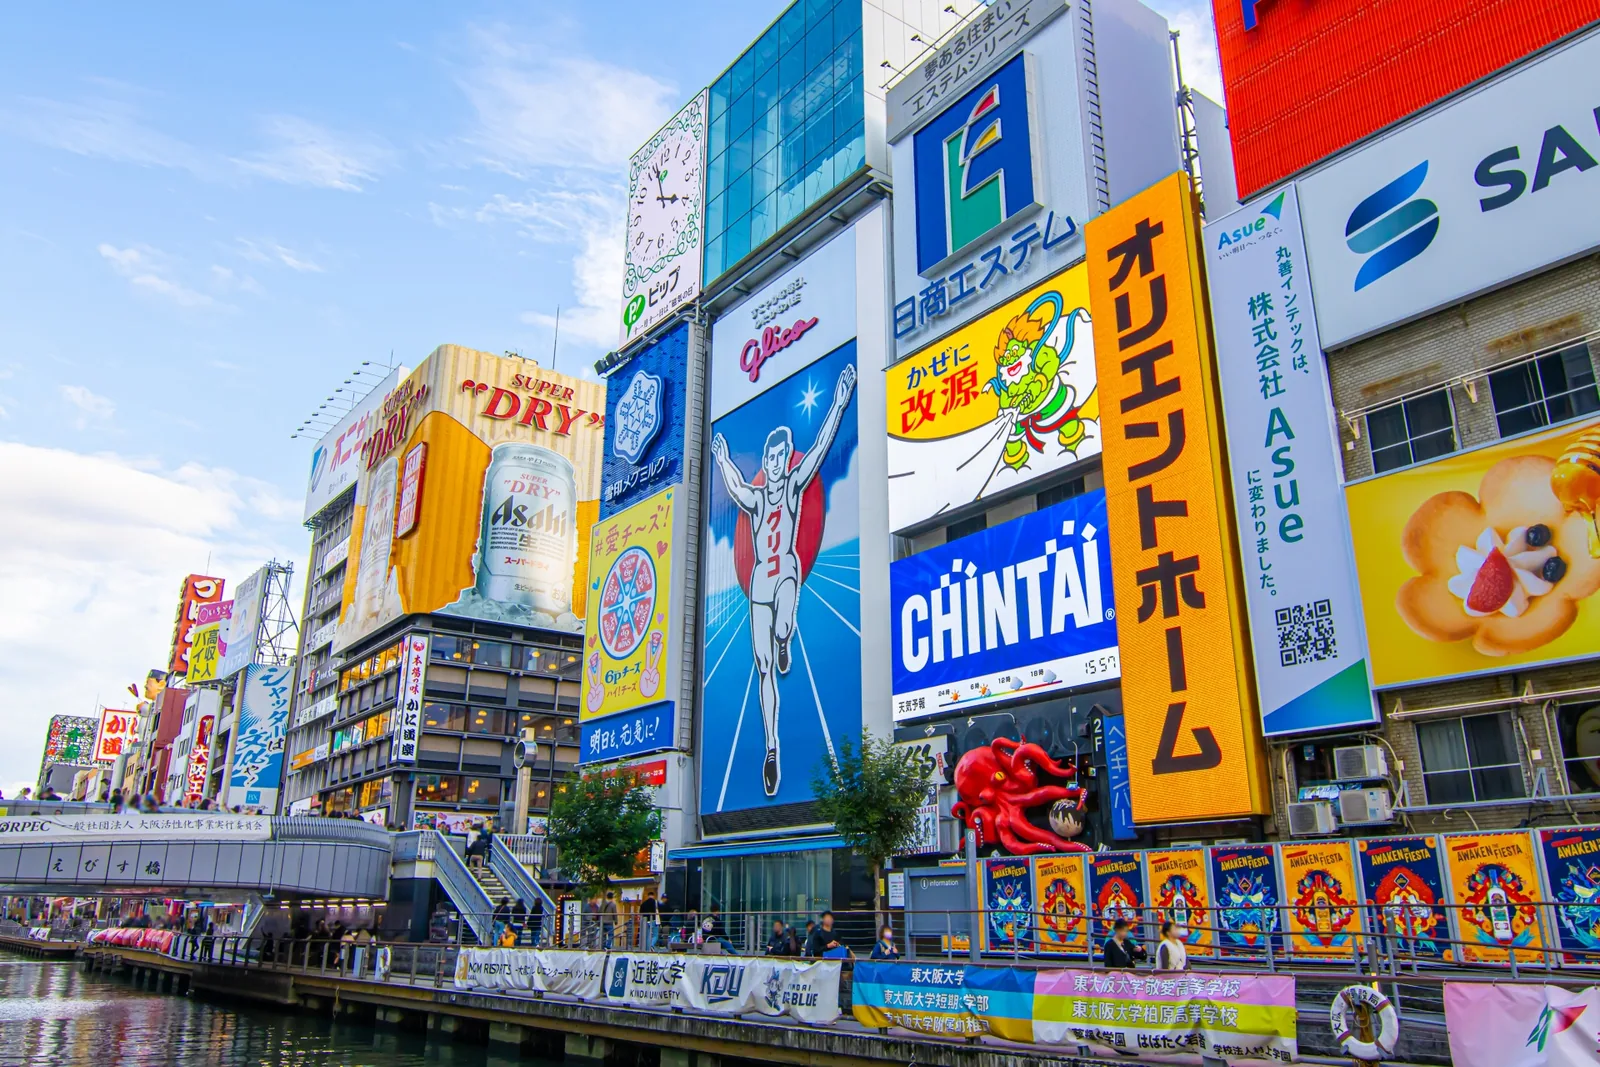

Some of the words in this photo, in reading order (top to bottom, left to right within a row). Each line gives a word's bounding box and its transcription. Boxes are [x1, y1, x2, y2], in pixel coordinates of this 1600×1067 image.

[924, 1, 1012, 82] 夢ある住まい
[912, 8, 1030, 116] エステムシリーズ
[660, 147, 671, 166] 12
[674, 143, 682, 159] 1
[681, 149, 692, 166] 2
[1474, 105, 1600, 213] SA
[685, 168, 695, 183] 3
[637, 187, 648, 205] 10
[681, 195, 690, 207] 4
[635, 231, 645, 247] 8
[645, 239, 654, 255] 7
[657, 232, 665, 249] 6
[1218, 216, 1266, 251] Asue
[1218, 227, 1284, 260] いい明日へ、つなぐ。
[649, 265, 681, 307] ピップ
[894, 210, 1078, 340] 日商エステム
[1275, 245, 1310, 375] 丸善インテックは、
[740, 317, 819, 383] Glico
[1248, 291, 1286, 400] 株式会社
[906, 343, 971, 391] かぜに
[511, 373, 575, 403] SUPER
[900, 361, 980, 435] 改源
[520, 473, 548, 485] SUPER
[604, 455, 667, 502] 雪印メグミルク
[1265, 407, 1304, 543] Asue
[1107, 217, 1223, 775] オリエントホーム
[491, 494, 567, 538] Asahi
[766, 505, 784, 578] グリコ
[1247, 469, 1277, 597] に変わりました。
[901, 520, 1104, 673] CHINTAI
[191, 632, 207, 680] バイト
[409, 655, 423, 696] 本場の味
[607, 681, 638, 698] ハイ!チーズ
[259, 667, 291, 752] シャッターは
[898, 696, 926, 714] 天気予報
[401, 698, 420, 757] かに道楽
[590, 716, 660, 756] 明日も、元気に!
[1093, 718, 1103, 752] 2F
[61, 819, 134, 832] 一般社団法人
[138, 818, 263, 832] 大阪活性化事業実行委員会
[1290, 854, 1320, 868] AWAKEN
[1320, 853, 1343, 866] FIESTA
[1371, 850, 1404, 866] AWAKEN
[1404, 849, 1431, 862] FIESTA
[1457, 847, 1493, 863] AWAKEN
[1495, 844, 1523, 859] FIESTA
[1557, 840, 1597, 859] AWAKEN
[52, 858, 161, 876] えびす橋
[1096, 862, 1120, 876] AWAKEN
[1120, 862, 1137, 874] FIESTA
[1154, 859, 1179, 873] AWAKEN
[1179, 859, 1199, 872] FIESTA
[1221, 857, 1248, 872] AWAKEN
[1248, 856, 1269, 870] FIESTA
[929, 879, 959, 887] information
[631, 959, 686, 986] 近畿大学
[911, 967, 965, 986] 東大阪大学
[792, 993, 818, 1007] BLUE
[1073, 975, 1241, 999] 東大阪大学敬愛高等学校
[1072, 1000, 1239, 1028] 東大阪大学柏原高等学校
[1137, 1032, 1207, 1051] はばたく若者
